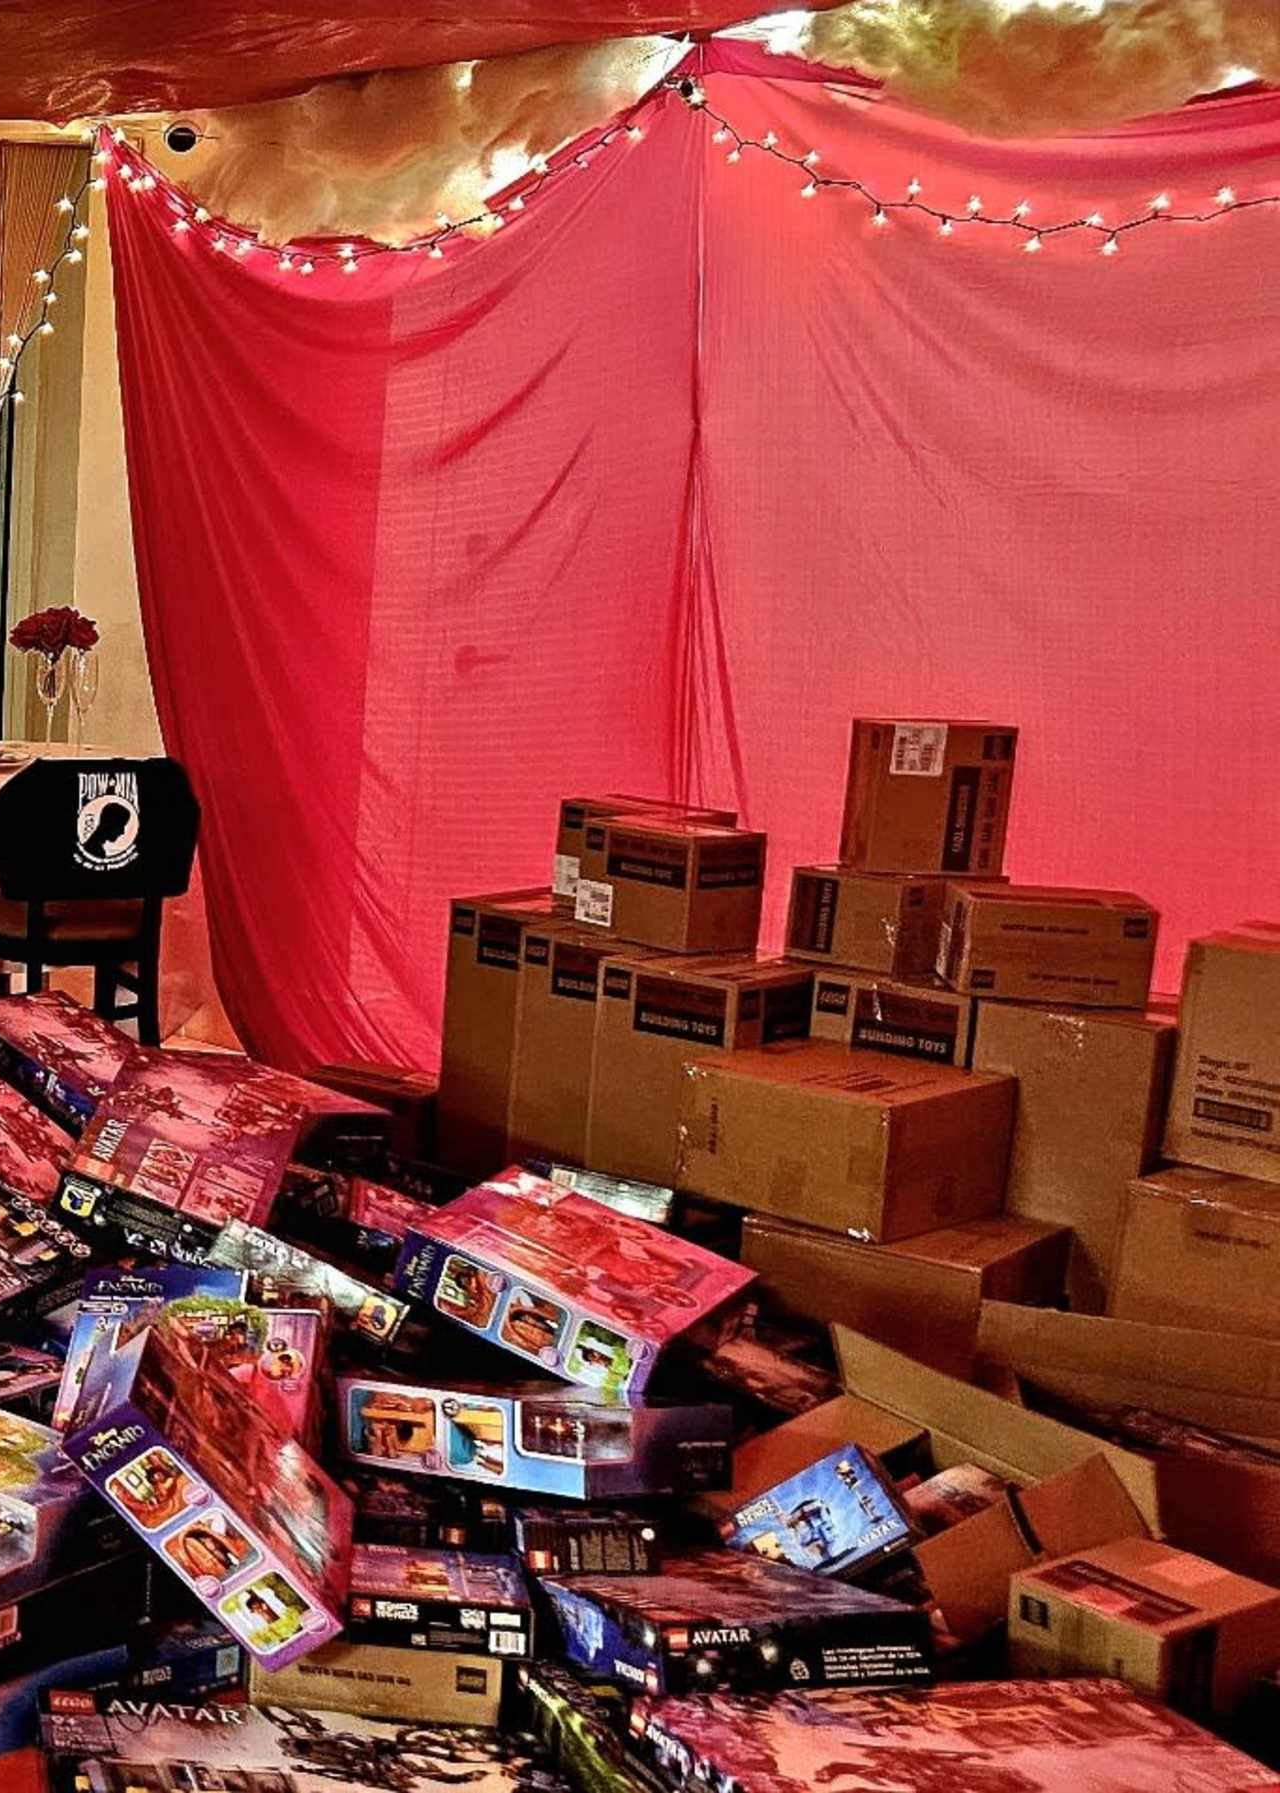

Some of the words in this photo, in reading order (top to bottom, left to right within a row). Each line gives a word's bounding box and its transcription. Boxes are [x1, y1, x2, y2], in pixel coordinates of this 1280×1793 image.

[78, 772, 110, 814] POW
[114, 772, 140, 814] MIA
[819, 990, 846, 1006] LEGO
[640, 1011, 689, 1032] BUILDING
[691, 1021, 718, 1036] TOYS
[858, 1028, 914, 1049] BUILDING
[917, 1037, 948, 1054] TOYS
[92, 1119, 129, 1161] AVATAR
[96, 1280, 164, 1293] ENCANTO
[81, 1425, 146, 1472] ENCANTO
[856, 1519, 901, 1548] AVATAR
[692, 1628, 751, 1645] AVATAR
[53, 1696, 91, 1708] LEGO
[108, 1699, 243, 1725] AVATAR
